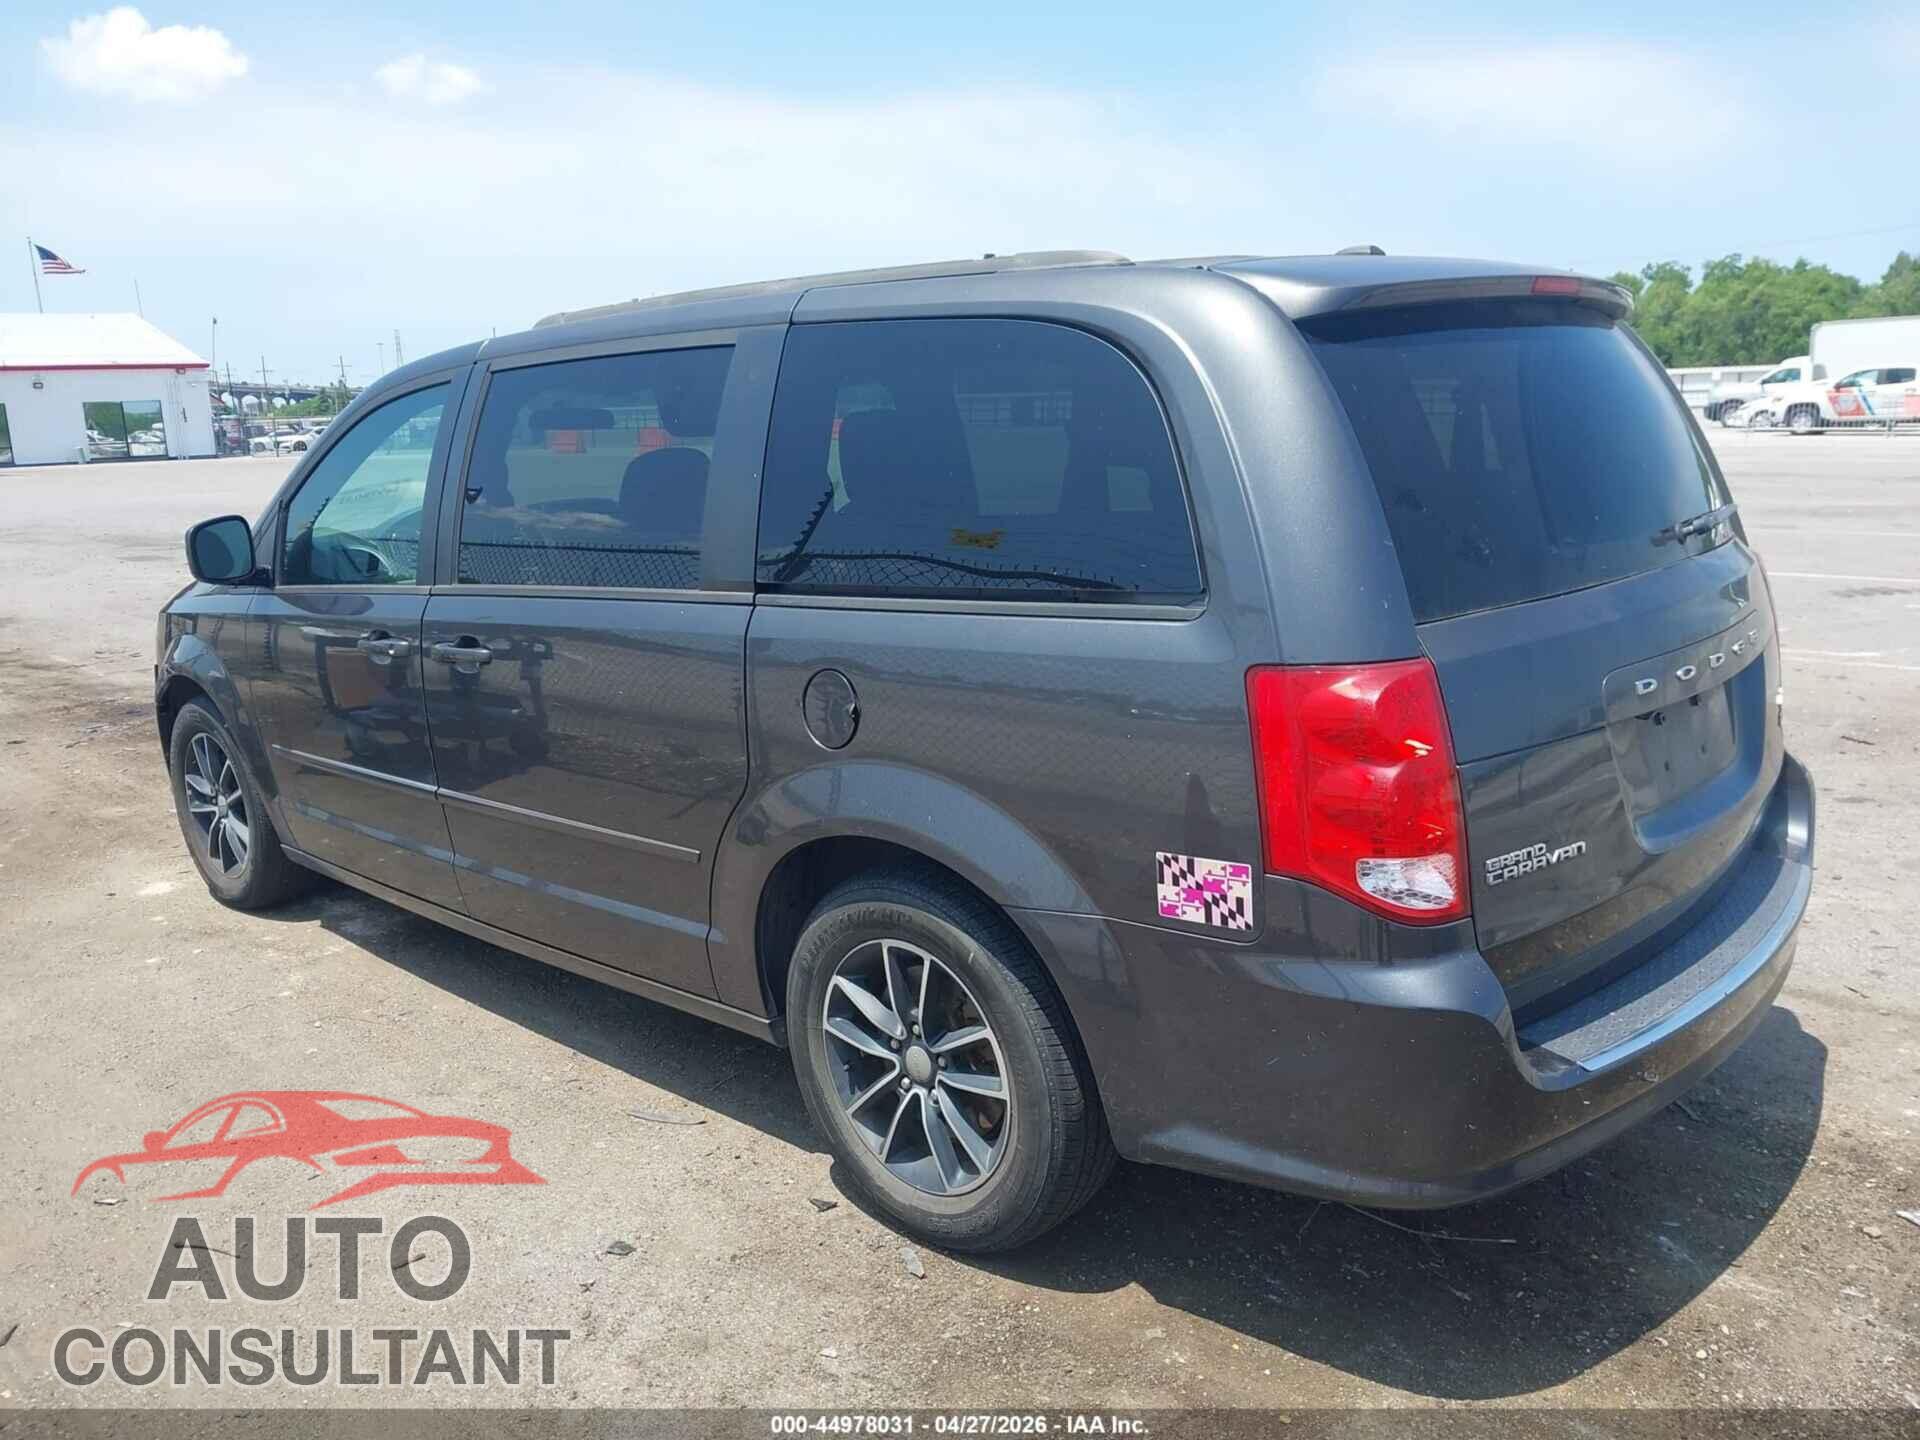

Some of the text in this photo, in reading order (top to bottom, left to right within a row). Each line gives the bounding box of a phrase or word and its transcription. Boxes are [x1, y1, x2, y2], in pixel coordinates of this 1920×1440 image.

[1635, 629, 1759, 696] DODGE
[1486, 843, 1547, 872] GRAND
[1486, 841, 1586, 887] CARAVAN
